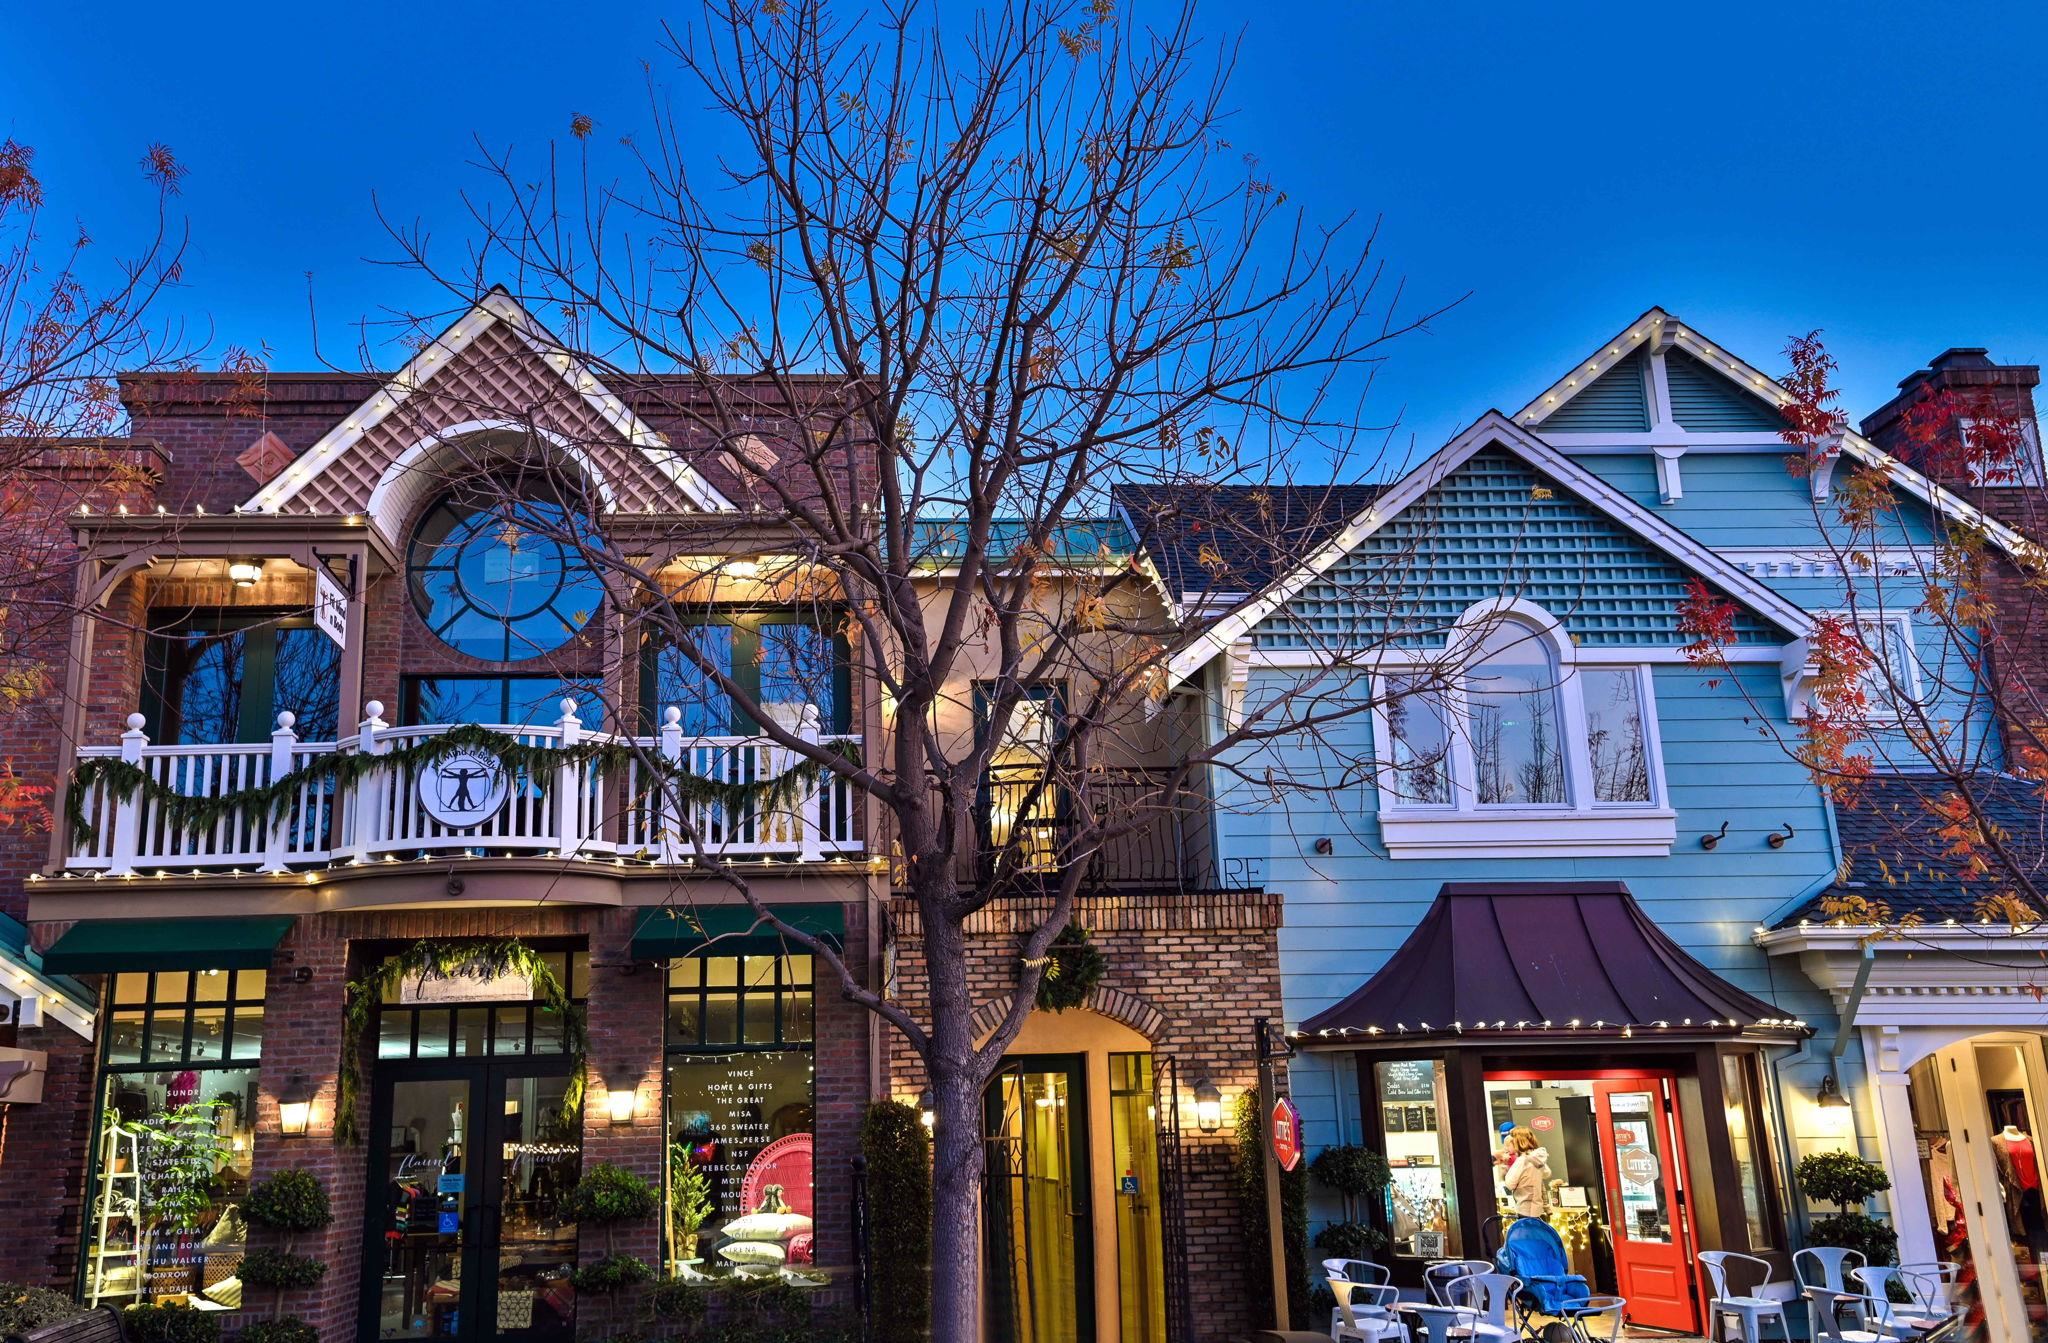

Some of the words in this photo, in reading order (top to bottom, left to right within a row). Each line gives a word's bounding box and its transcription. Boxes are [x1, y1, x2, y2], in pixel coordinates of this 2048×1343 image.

[334, 615, 344, 640] Body
[727, 1070, 755, 1078] VINCE
[737, 1083, 744, 1091] &
[716, 1097, 733, 1105] THE
[736, 1096, 764, 1104] GREAT
[728, 1110, 752, 1118] MISA
[731, 1123, 769, 1131] SWEATER
[711, 1137, 739, 1145] JAMES
[743, 1136, 771, 1144] PERSE
[170, 1143, 182, 1151] OF
[731, 1150, 749, 1158] NSF
[398, 1151, 457, 1177] flaunt
[702, 1163, 741, 1172] REBECCA
[176, 1226, 201, 1236] GELA
[155, 1240, 176, 1250] AND
[171, 1254, 210, 1265] WALKER
[138, 1286, 164, 1295] ELLA
[169, 1283, 194, 1293] DAHL
